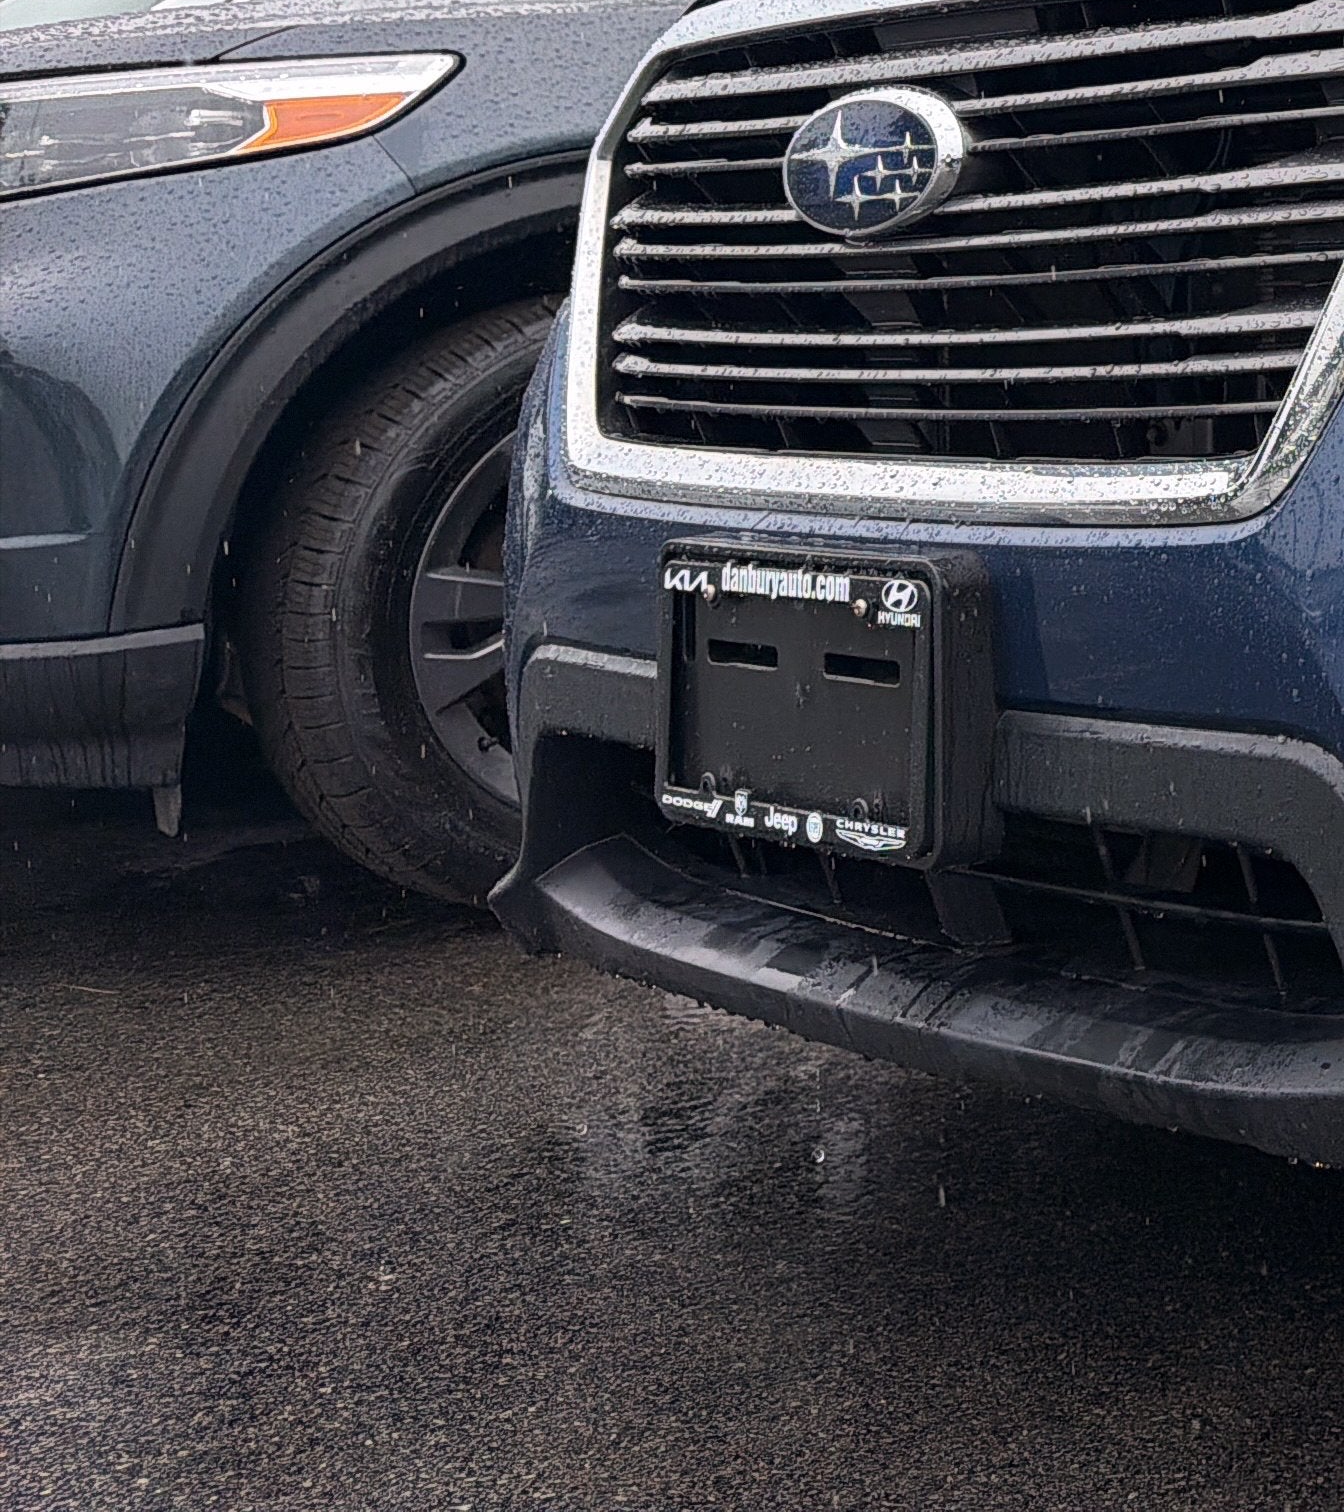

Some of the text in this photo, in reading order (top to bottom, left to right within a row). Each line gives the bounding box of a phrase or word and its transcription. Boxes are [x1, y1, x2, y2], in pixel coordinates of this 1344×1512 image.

[664, 568, 708, 591] KIA
[721, 562, 850, 602] danburyauto.com
[877, 611, 921, 628] HYUNDAI
[662, 794, 714, 813] DODGE
[725, 813, 754, 827] RAM
[764, 806, 797, 836] Jeep
[836, 818, 906, 838] CHRYSLER
